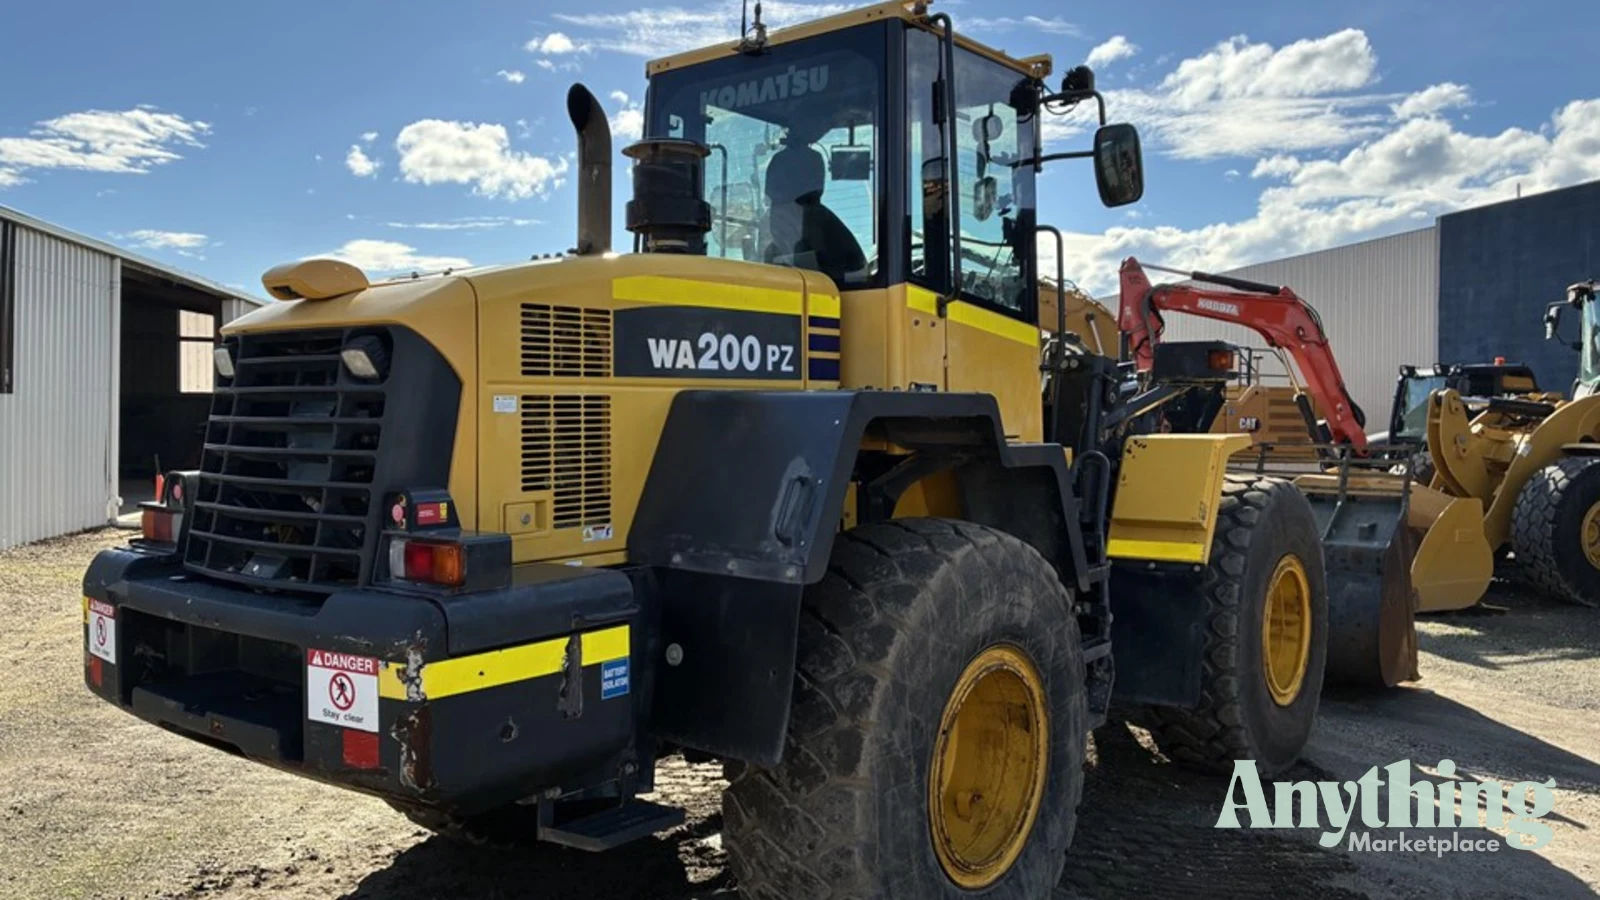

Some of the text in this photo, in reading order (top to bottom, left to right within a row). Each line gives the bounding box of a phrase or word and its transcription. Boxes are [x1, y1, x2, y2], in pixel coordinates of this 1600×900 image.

[700, 64, 829, 110] KOMATSU
[1239, 417, 1257, 430] CAT
[324, 652, 374, 673] DANGER
[322, 708, 364, 724] Stay clear
